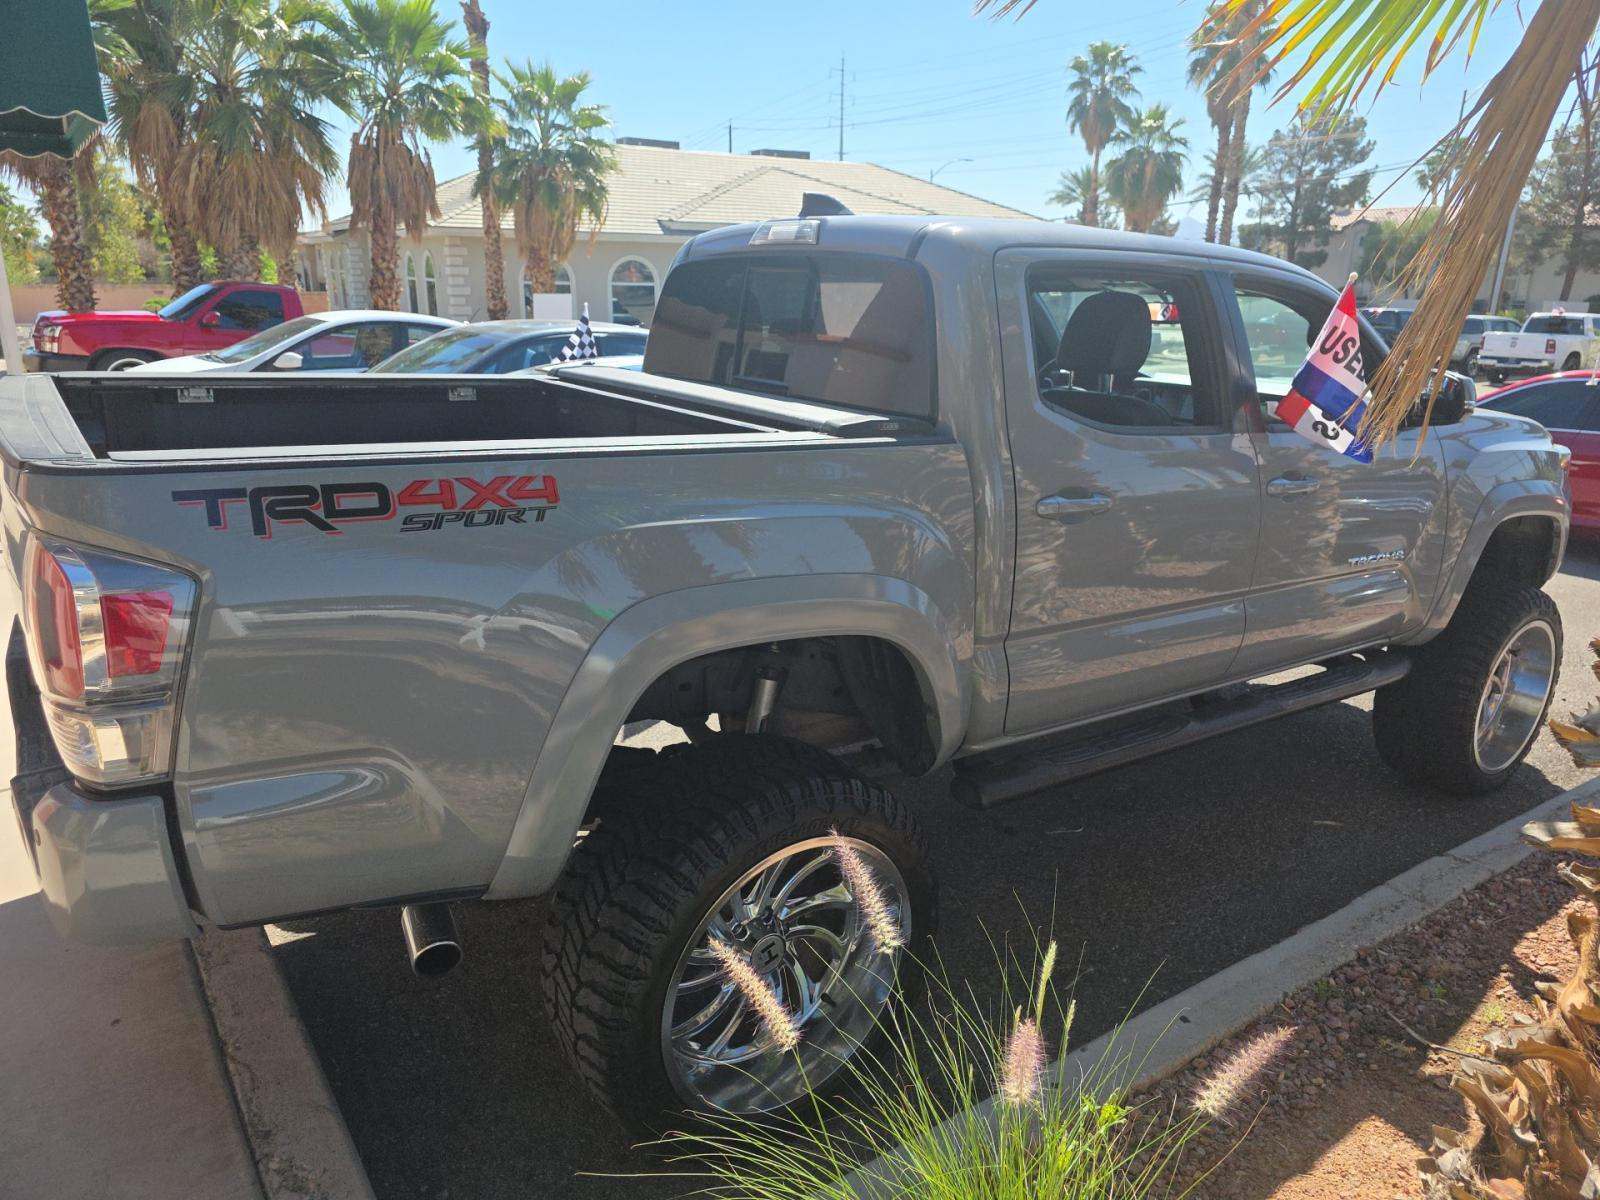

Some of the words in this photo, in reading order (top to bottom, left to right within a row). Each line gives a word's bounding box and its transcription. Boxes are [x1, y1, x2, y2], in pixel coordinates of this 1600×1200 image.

[171, 482, 398, 539] TRD
[397, 474, 561, 509] 4X4
[399, 505, 558, 533] SPORT
